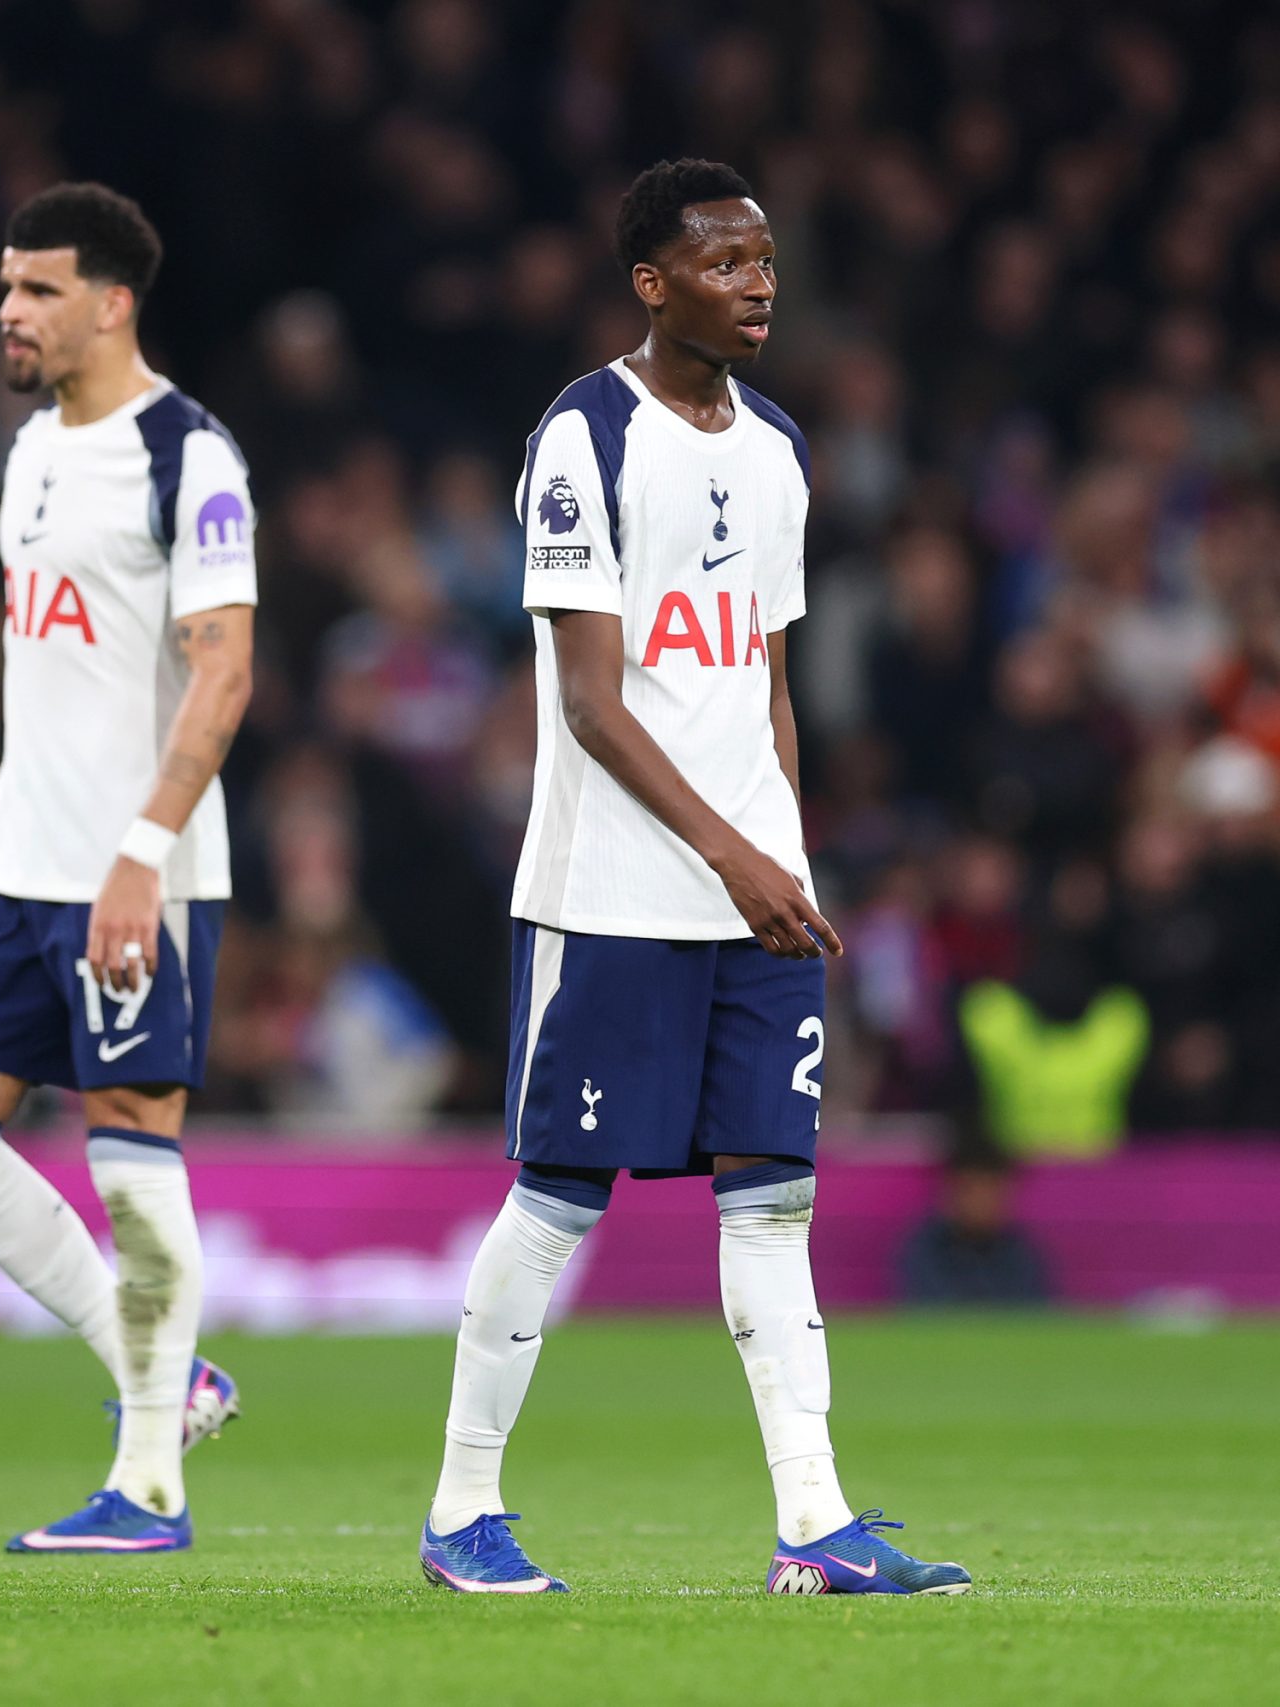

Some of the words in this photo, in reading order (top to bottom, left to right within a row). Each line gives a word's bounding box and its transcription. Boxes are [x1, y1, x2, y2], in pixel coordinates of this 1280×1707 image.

[531, 547, 548, 559] No
[549, 548, 585, 559] room
[641, 590, 767, 667] AIA
